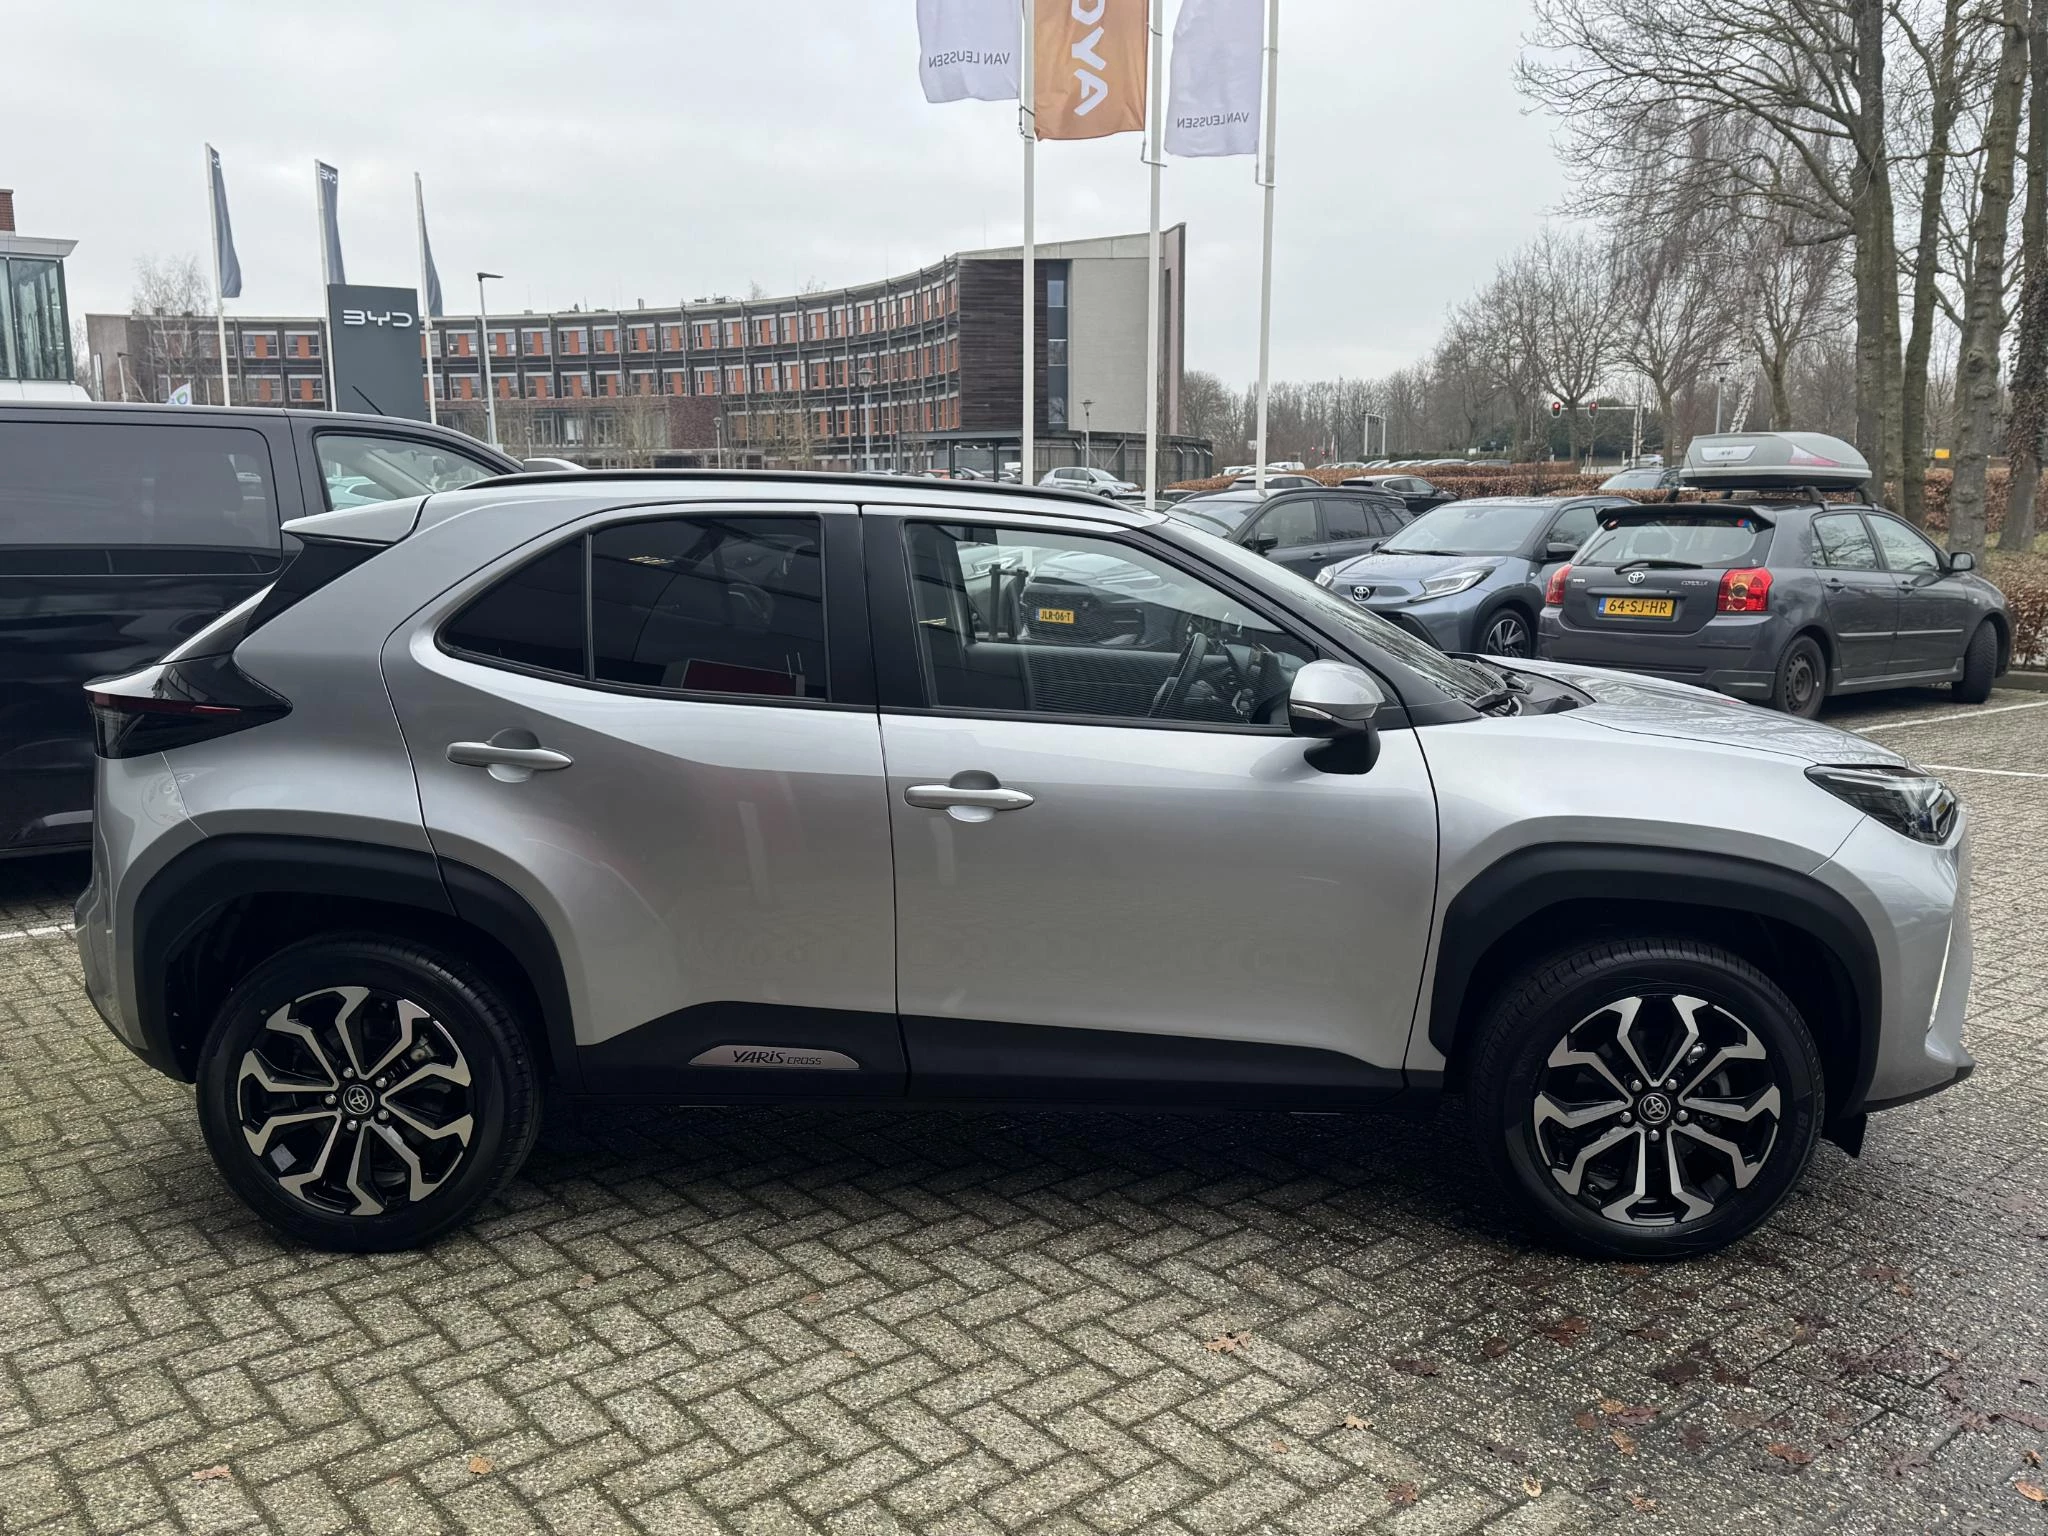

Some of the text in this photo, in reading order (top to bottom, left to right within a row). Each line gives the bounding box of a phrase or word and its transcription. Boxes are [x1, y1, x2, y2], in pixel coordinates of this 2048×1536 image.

[343, 309, 413, 327] BYD
[1609, 599, 1668, 614] 64-SJ-HR
[1041, 610, 1071, 621] JLR-06-T
[786, 1056, 822, 1065] CROSS
